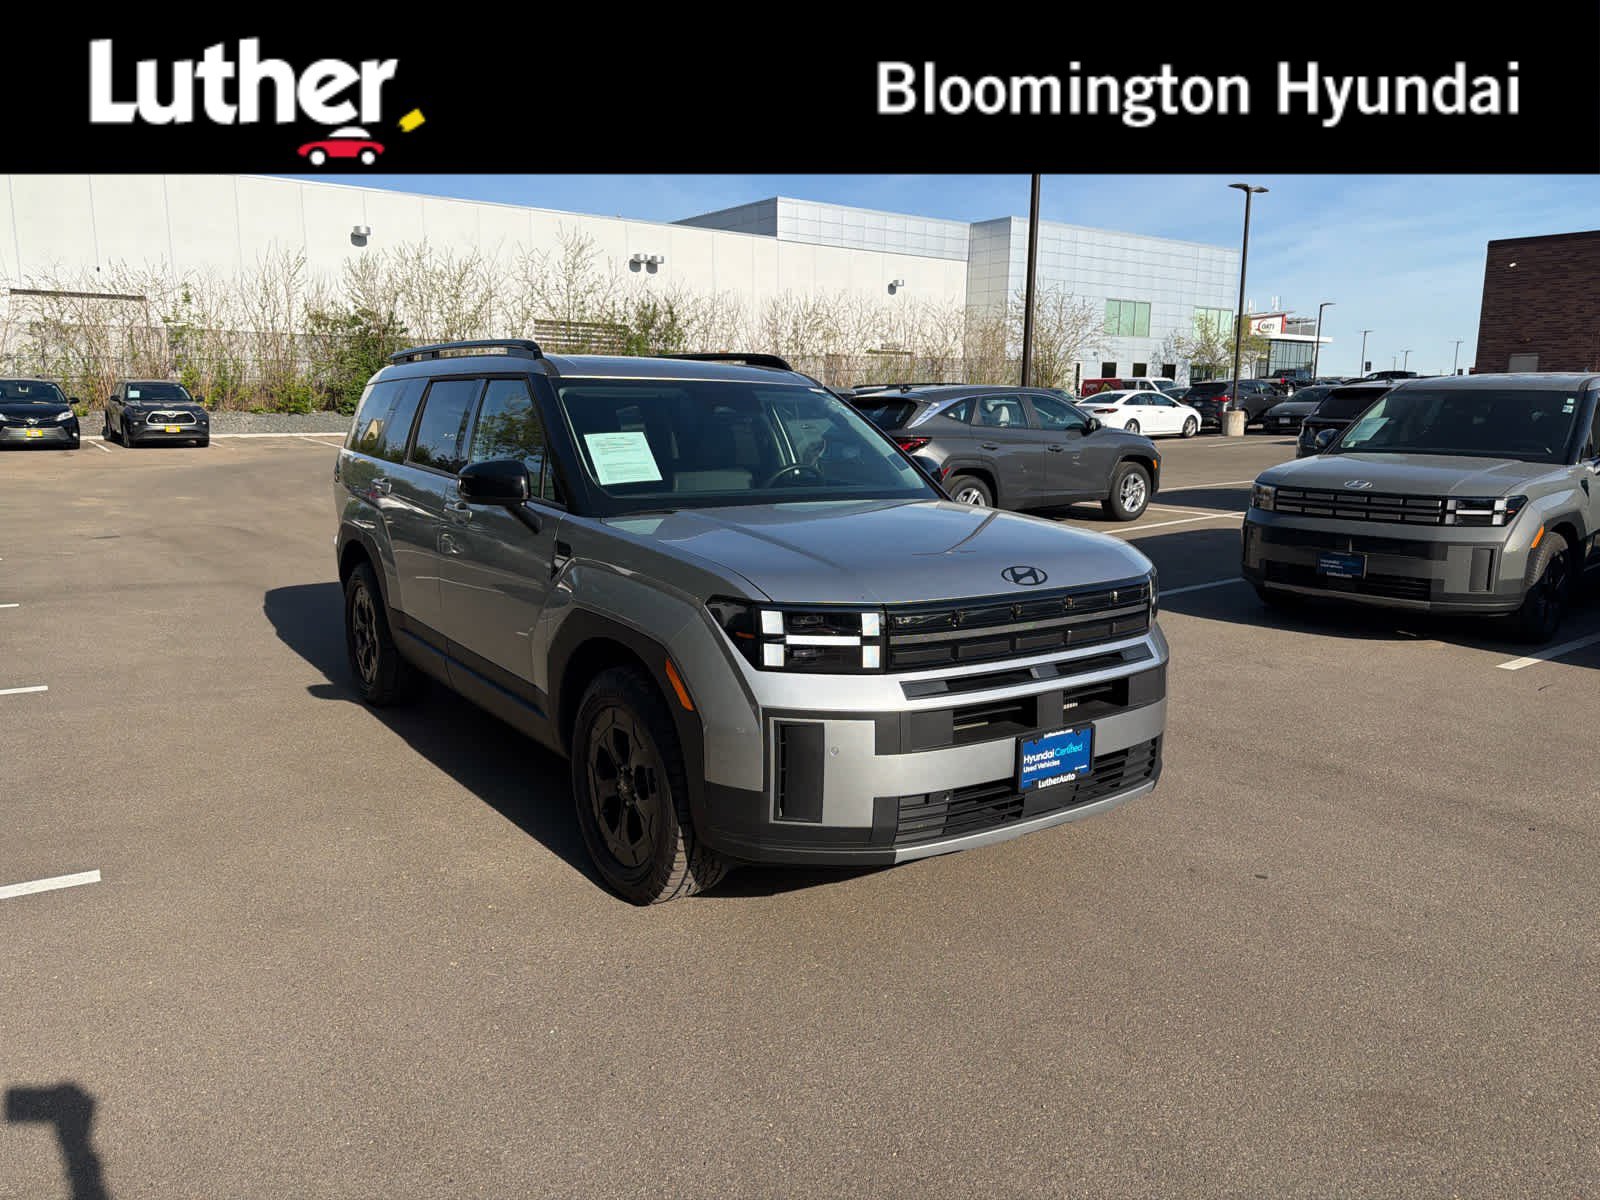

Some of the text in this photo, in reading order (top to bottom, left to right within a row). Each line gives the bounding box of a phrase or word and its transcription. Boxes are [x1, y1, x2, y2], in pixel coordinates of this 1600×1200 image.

[1023, 743, 1083, 764] Hyundai Certified
[1023, 760, 1060, 773] Used Vehicles
